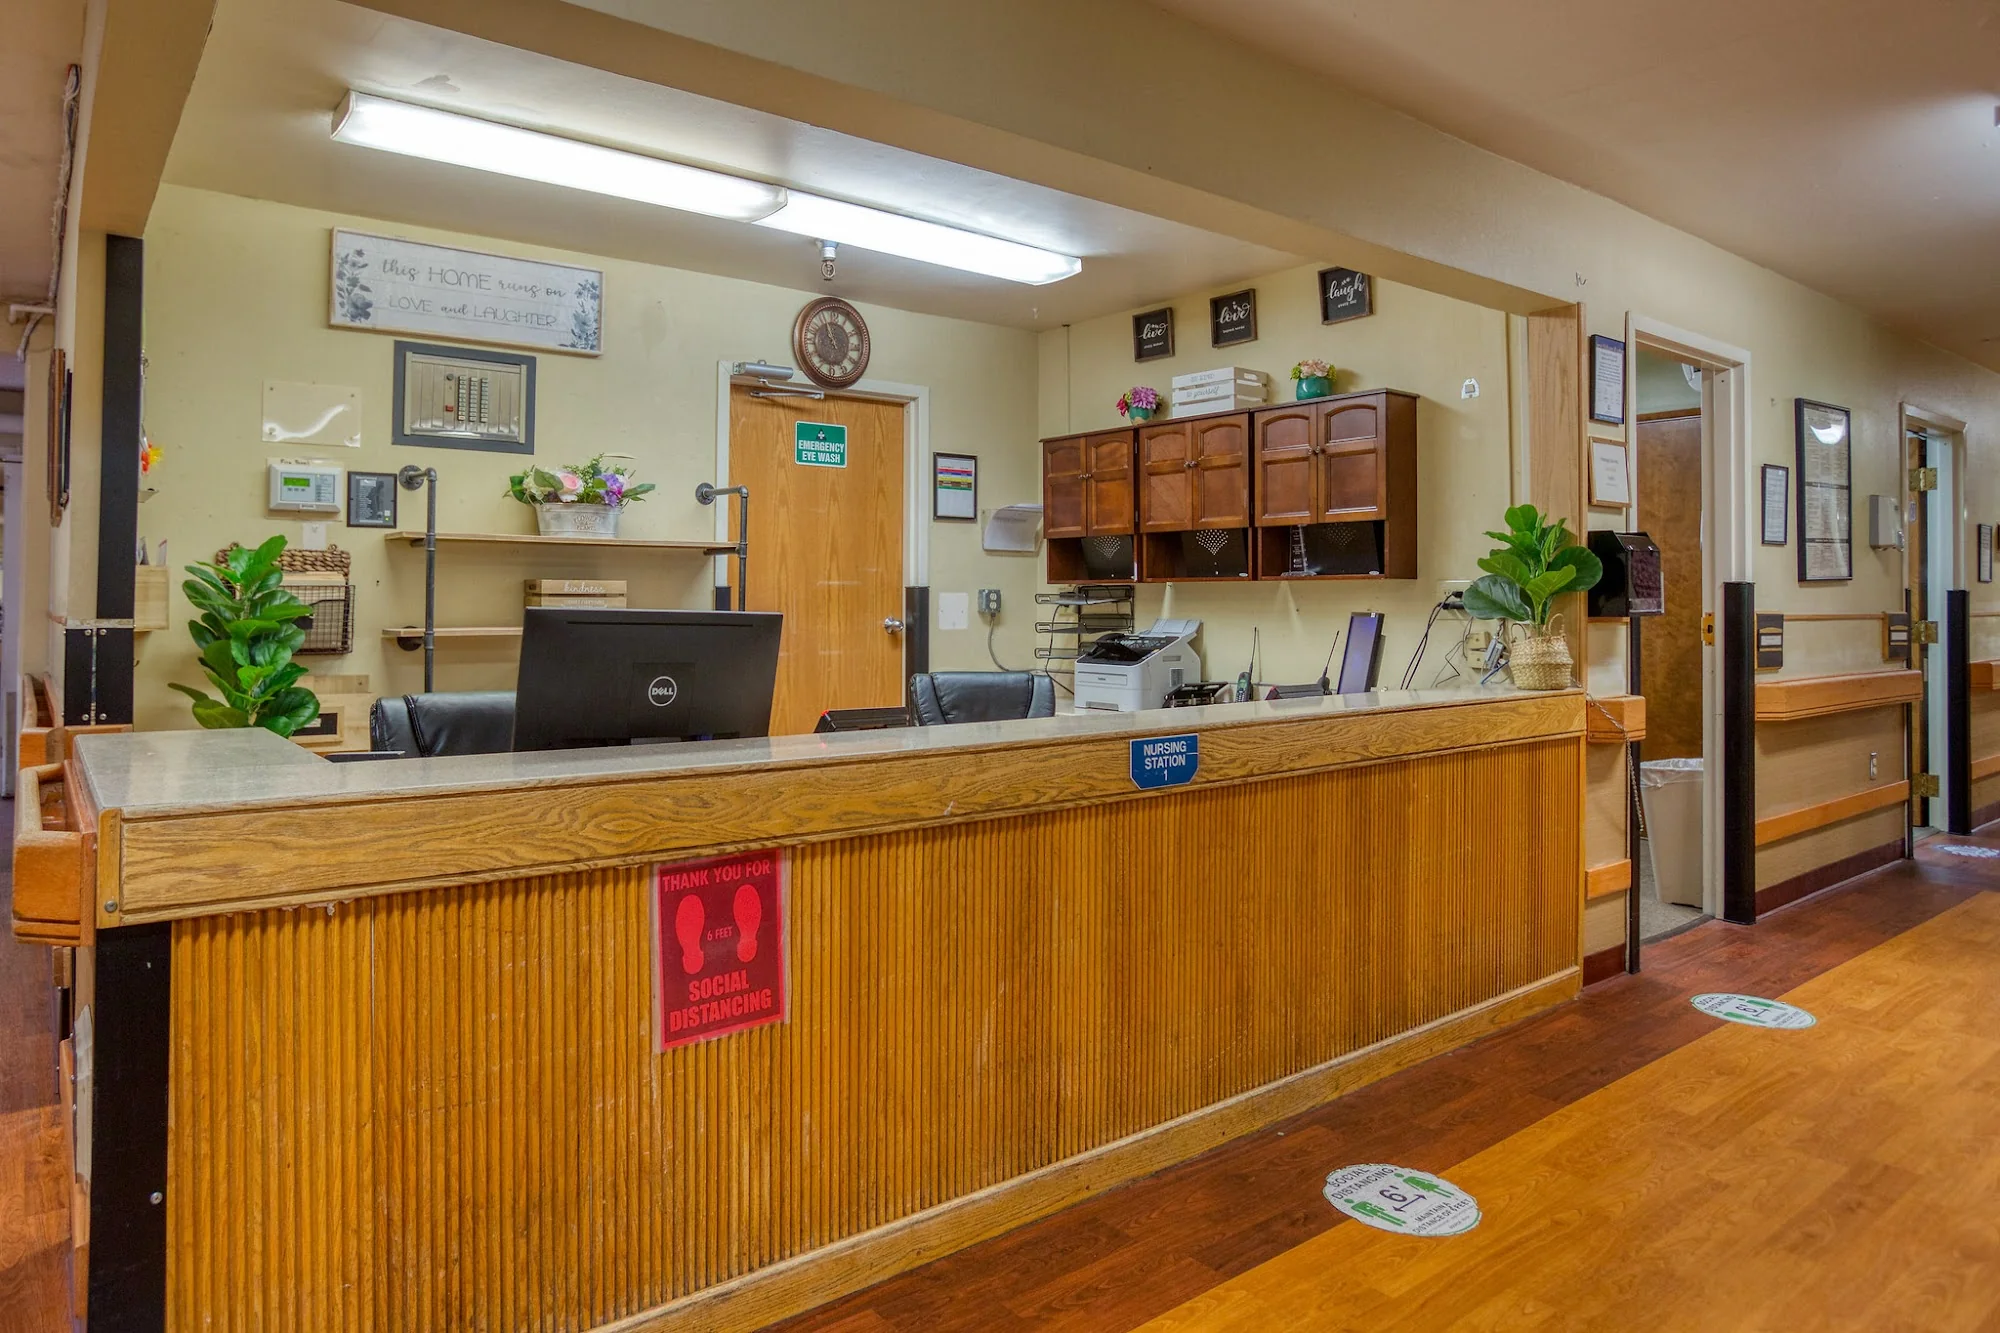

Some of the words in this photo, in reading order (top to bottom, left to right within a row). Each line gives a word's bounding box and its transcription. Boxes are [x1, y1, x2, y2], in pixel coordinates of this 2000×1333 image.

[382, 259, 419, 282] this
[428, 266, 492, 291] HOME
[498, 280, 541, 298] runs
[546, 288, 567, 299] on
[1327, 272, 1365, 302] laugh
[389, 295, 433, 313] LOVE
[440, 304, 468, 315] and
[473, 305, 558, 327] LAUGHTER
[1217, 303, 1250, 324] love
[1138, 322, 1168, 340] live
[798, 440, 845, 453] EMERGENCY
[802, 451, 816, 461] EYE
[818, 452, 841, 464] WASH
[652, 686, 674, 696] DELL
[1143, 740, 1187, 756] NURSING
[1144, 754, 1186, 770] STATION
[1163, 769, 1168, 781] 1
[662, 869, 709, 892] THANK
[714, 864, 742, 884] YOU
[745, 859, 771, 877] FOR
[706, 930, 713, 941] 6
[715, 926, 733, 940] FEET
[688, 969, 750, 1002] SOCIAL
[669, 988, 772, 1033] DISTANCING
[1328, 1167, 1370, 1188] SOCIAL
[1331, 1166, 1395, 1200] DISTANCING
[1412, 1215, 1445, 1233] DISTANCE
[1455, 1199, 1472, 1211] FEET
[1414, 1204, 1446, 1222] MAINTAIN
